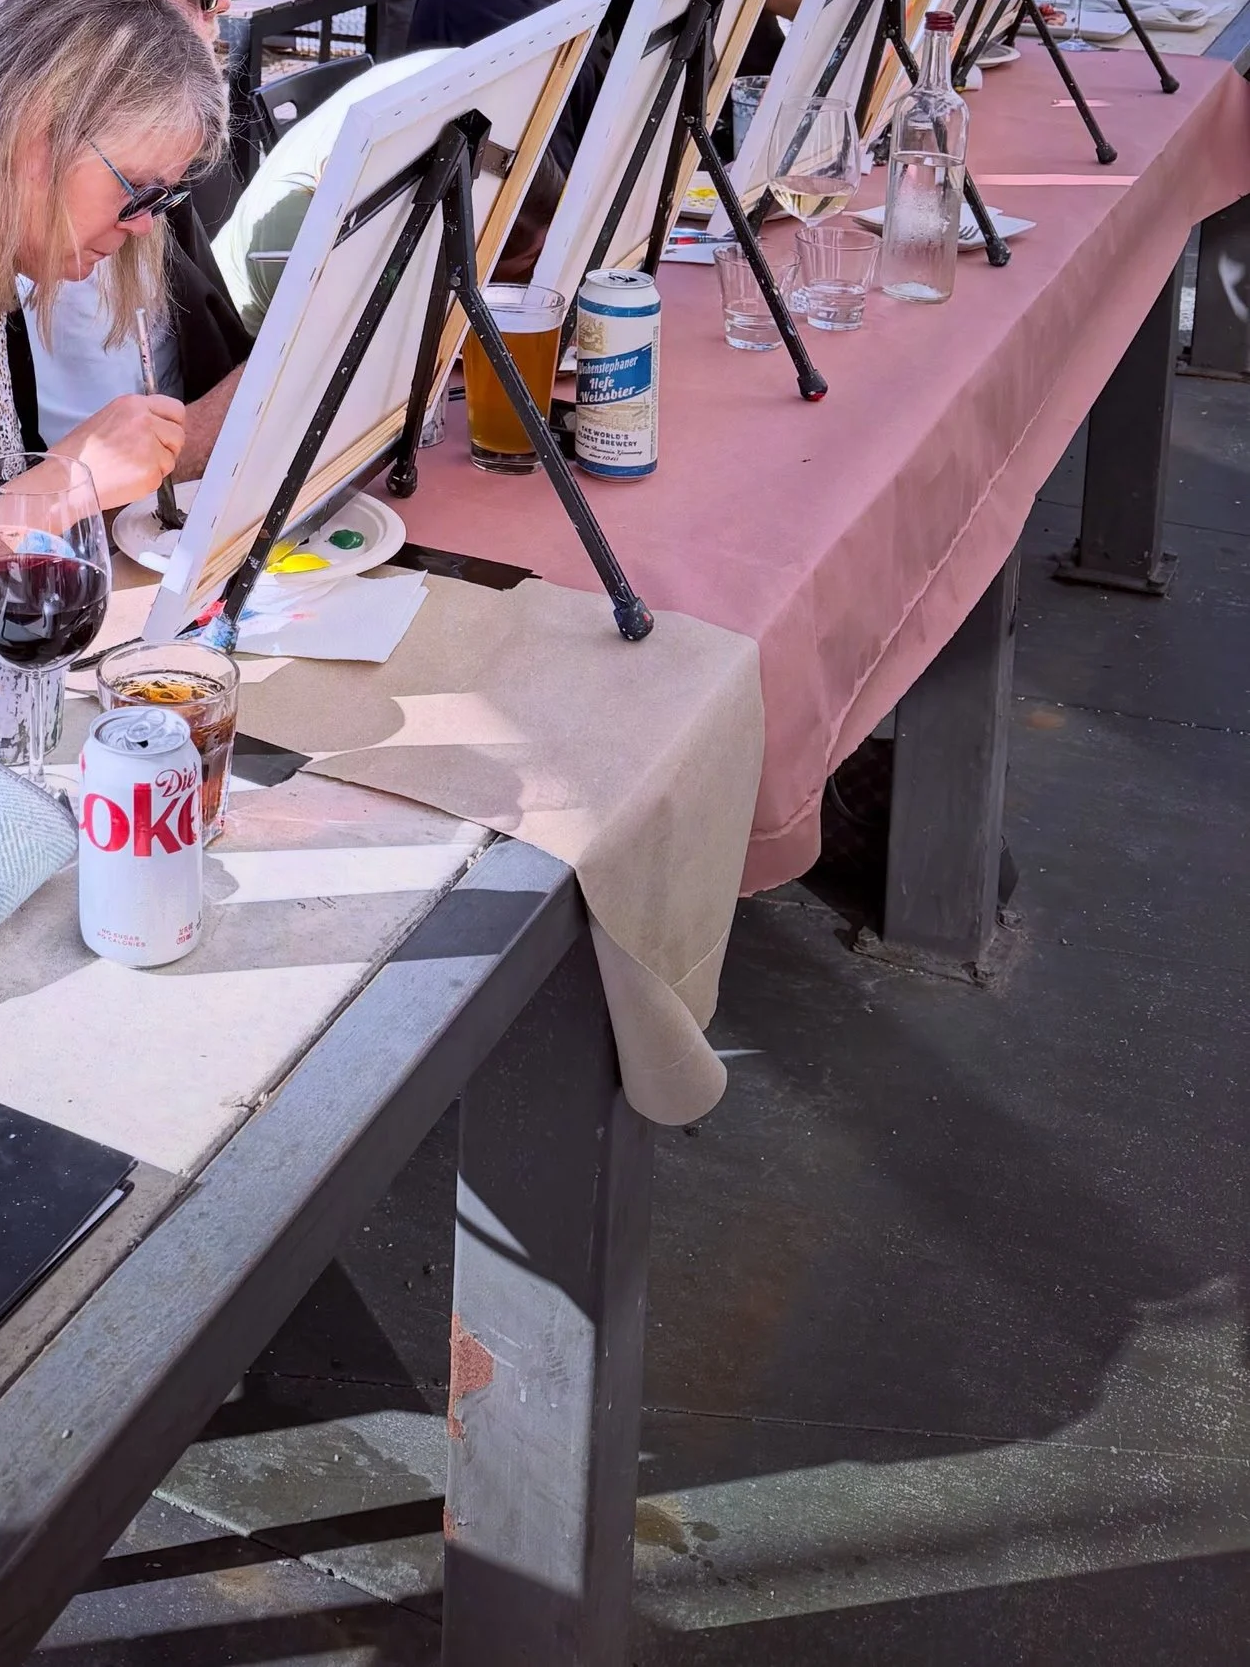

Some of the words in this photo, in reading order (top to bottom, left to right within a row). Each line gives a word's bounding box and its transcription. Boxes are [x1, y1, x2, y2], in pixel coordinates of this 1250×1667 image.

[589, 375, 615, 392] Hefe
[580, 385, 636, 403] Weissbier
[593, 429, 630, 440] WORLD'S
[600, 438, 638, 447] BREWERY
[79, 782, 203, 858] oke
